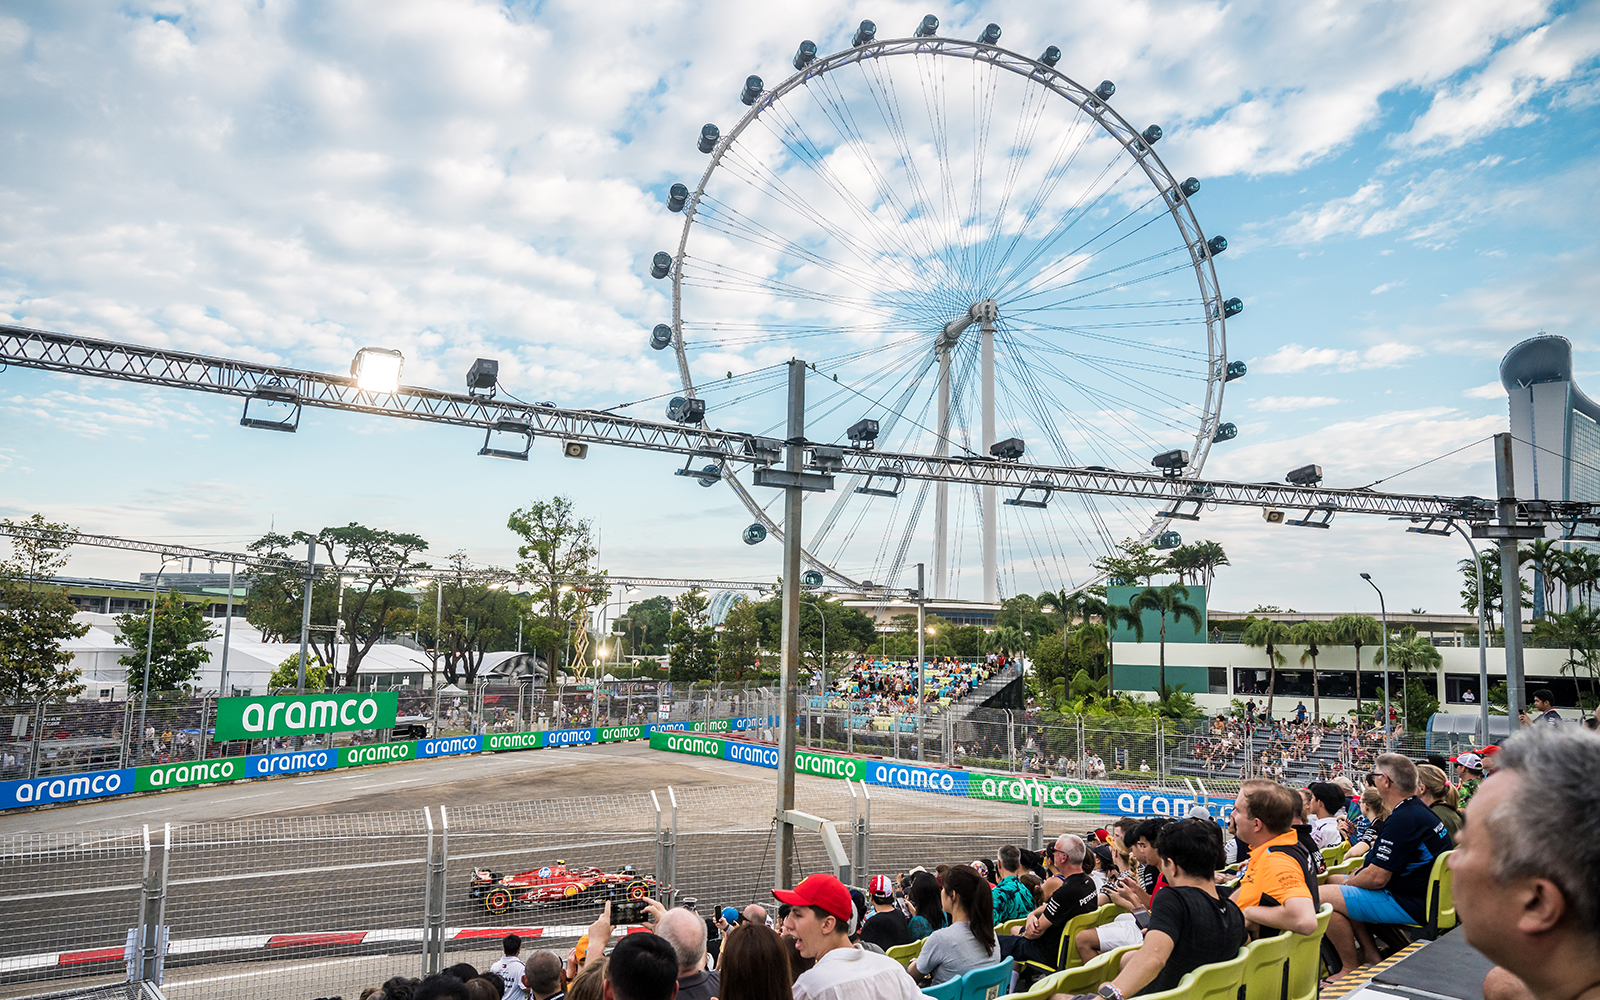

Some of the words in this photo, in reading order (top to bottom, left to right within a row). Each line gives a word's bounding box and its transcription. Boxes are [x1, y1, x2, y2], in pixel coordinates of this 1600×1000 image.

[242, 698, 378, 732] aramco
[548, 729, 592, 744] aramco
[600, 725, 641, 739] aramco
[694, 720, 728, 732] armco
[425, 737, 477, 755] aramco
[490, 734, 536, 748] aramco
[667, 736, 719, 755] aramco
[257, 752, 328, 773] aramco
[347, 744, 409, 763] aramco
[730, 744, 779, 766] aramco
[149, 761, 234, 786] aramco
[795, 754, 856, 778] aramco
[15, 773, 121, 802] aramco
[875, 765, 955, 792] aramco
[980, 778, 1083, 807] aramco
